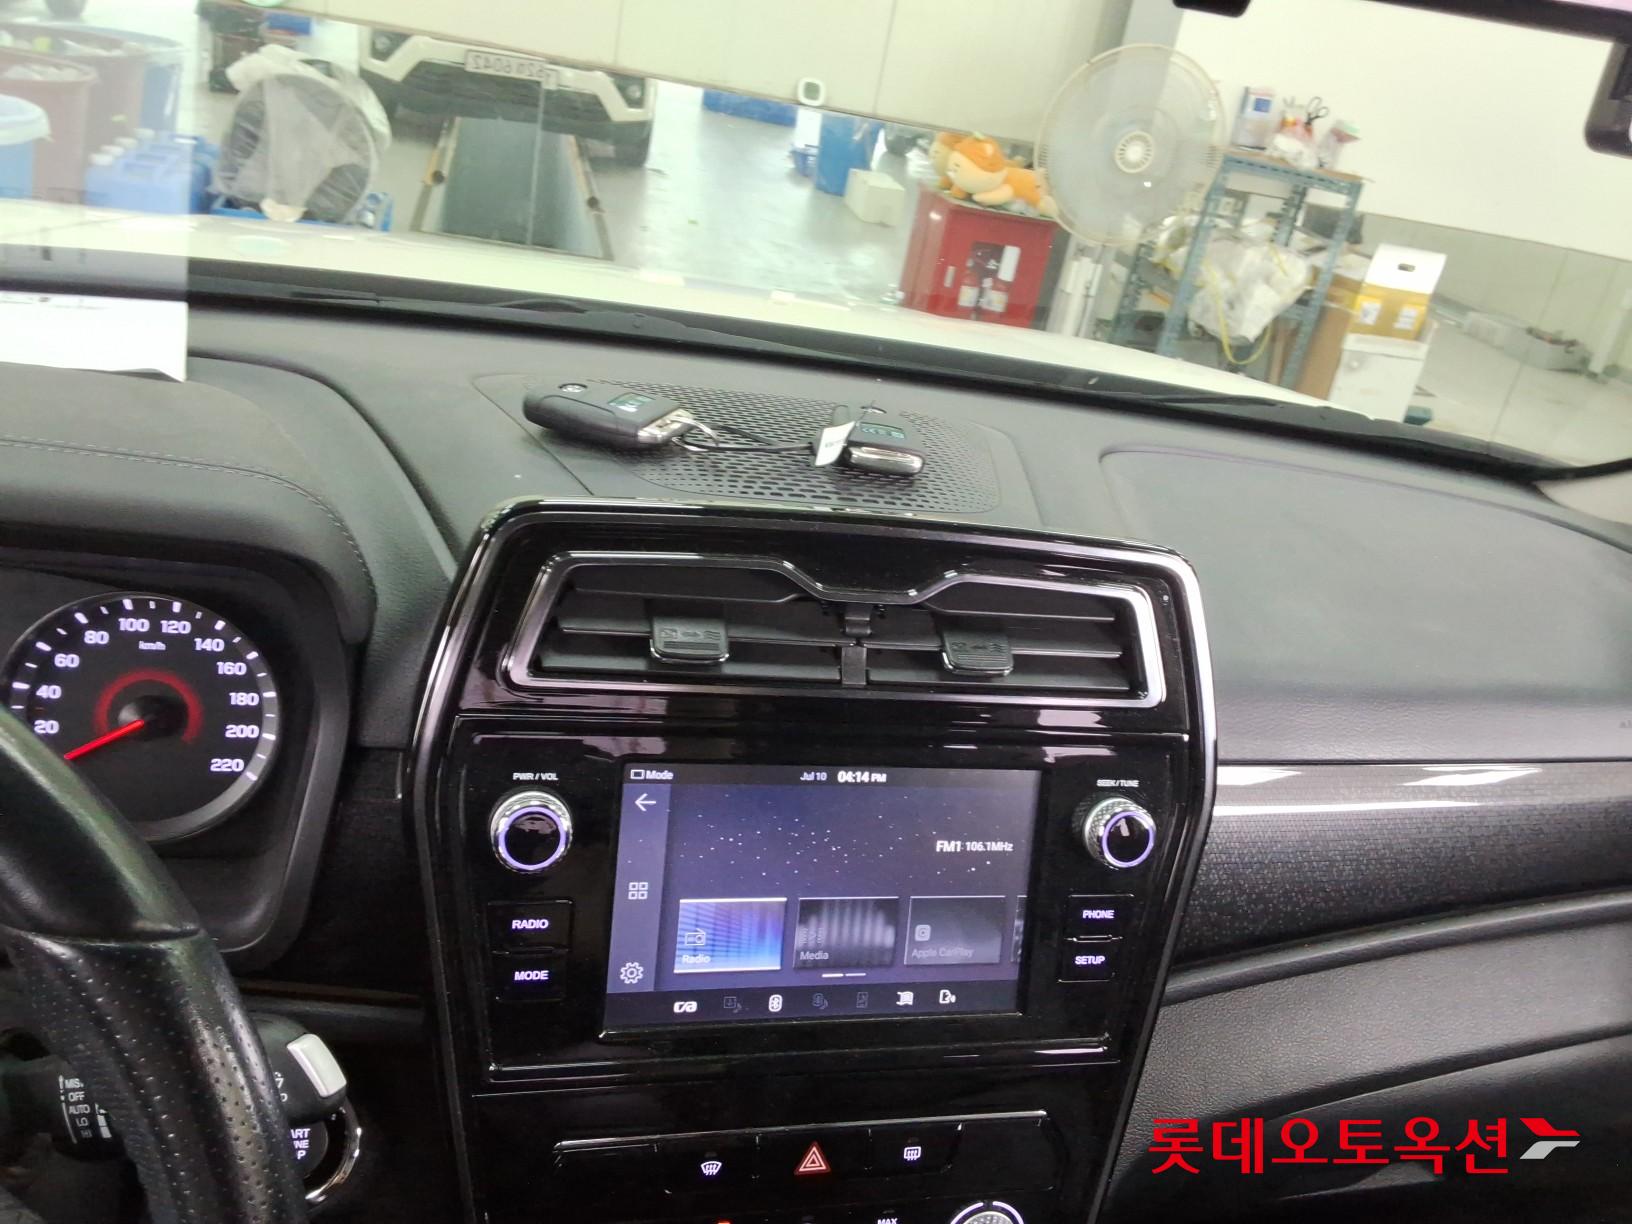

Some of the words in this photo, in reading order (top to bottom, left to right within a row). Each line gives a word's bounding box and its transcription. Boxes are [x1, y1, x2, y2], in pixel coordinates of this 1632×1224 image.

[118, 617, 150, 632] 100
[160, 620, 191, 634] 120
[84, 630, 109, 645] 80
[194, 637, 224, 652] 140
[54, 653, 80, 668] 60
[216, 661, 247, 675] 160
[36, 685, 62, 699] 40
[229, 692, 259, 706] 180
[34, 720, 59, 734] 20
[225, 724, 259, 738] 200
[210, 758, 244, 772] 220
[645, 769, 674, 781] Mode
[800, 771, 815, 781] Jul
[816, 771, 828, 781] 10
[837, 770, 870, 783] 04:14
[870, 773, 887, 783] PM
[936, 840, 961, 853] FM1
[1082, 909, 1115, 919] PHONE
[511, 918, 549, 930] RADIO
[681, 953, 711, 964] Radio
[799, 950, 829, 961] Media
[1075, 955, 1106, 965] SETUP
[514, 970, 549, 981] MODE
[68, 1091, 86, 1102] OFF
[68, 1104, 91, 1115] AUTO
